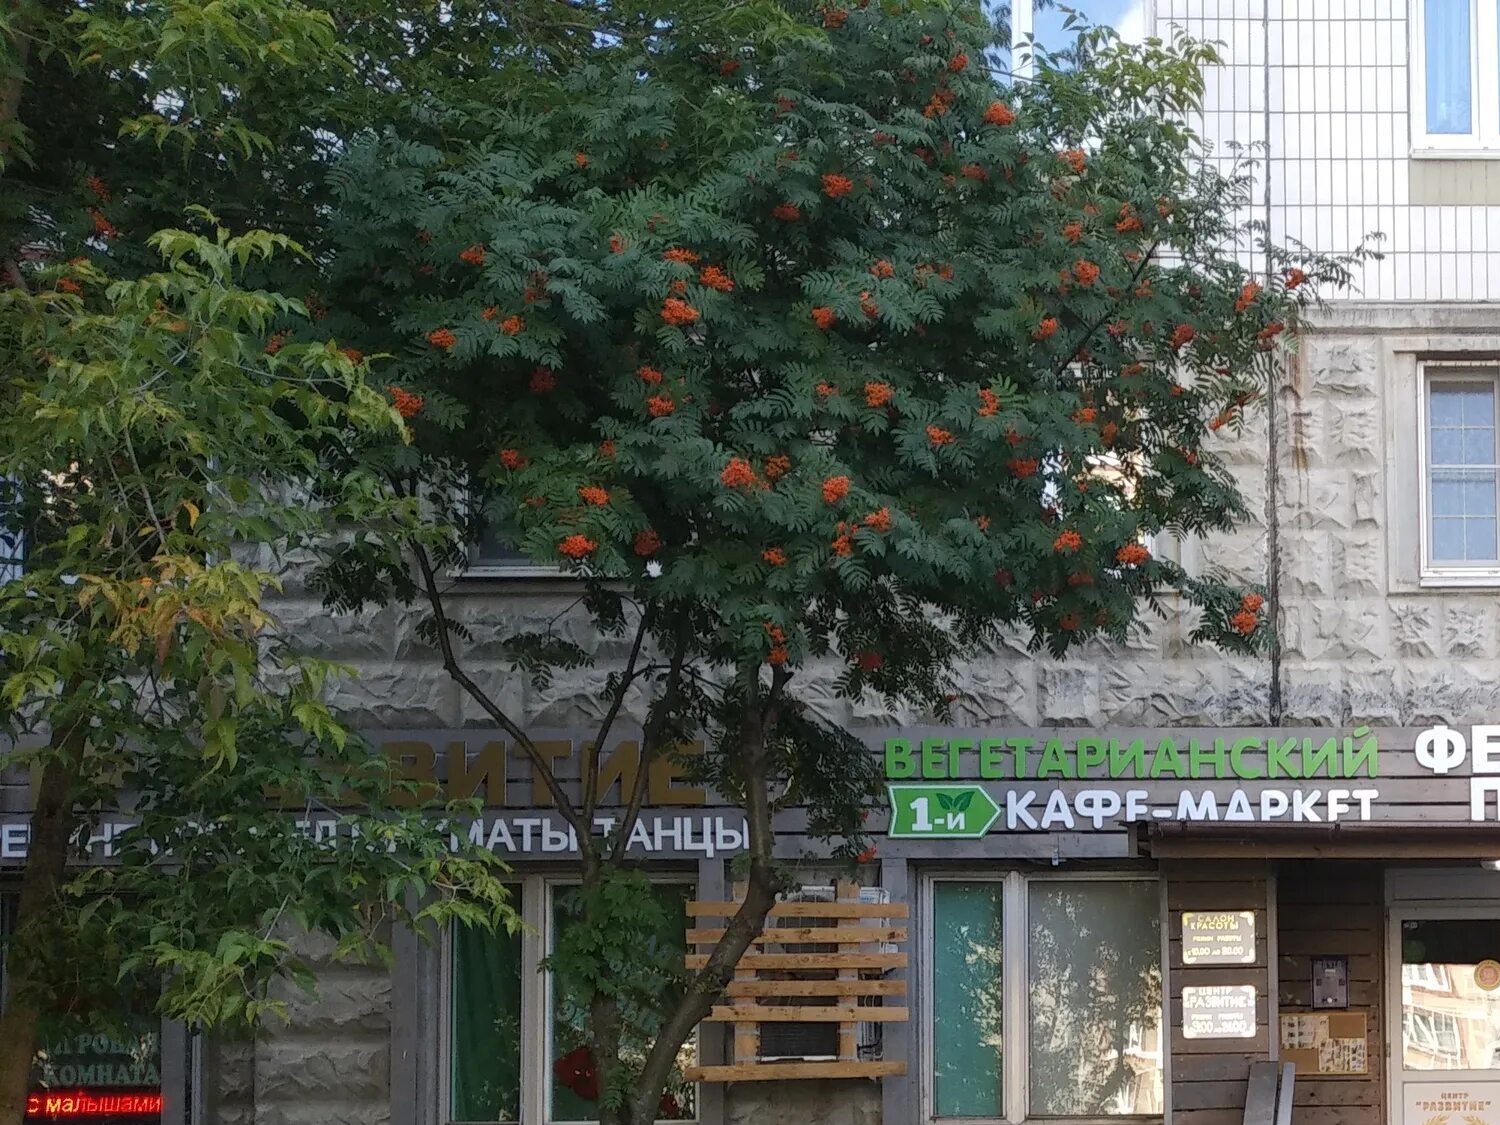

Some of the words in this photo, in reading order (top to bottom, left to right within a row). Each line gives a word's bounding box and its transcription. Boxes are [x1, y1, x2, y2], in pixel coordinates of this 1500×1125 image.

[262, 740, 708, 806] ВИТИЕ
[883, 725, 1380, 780] ВЕГЕТАРИАНСКИЙ
[1006, 788, 1380, 830] КАФЕ-МАРКЕТ
[593, 816, 750, 858] ТАНЦЫ
[1190, 922, 1239, 930] КРАСОТЫ
[45, 1064, 160, 1085] КОМНАТА
[45, 1097, 161, 1113] малышами
